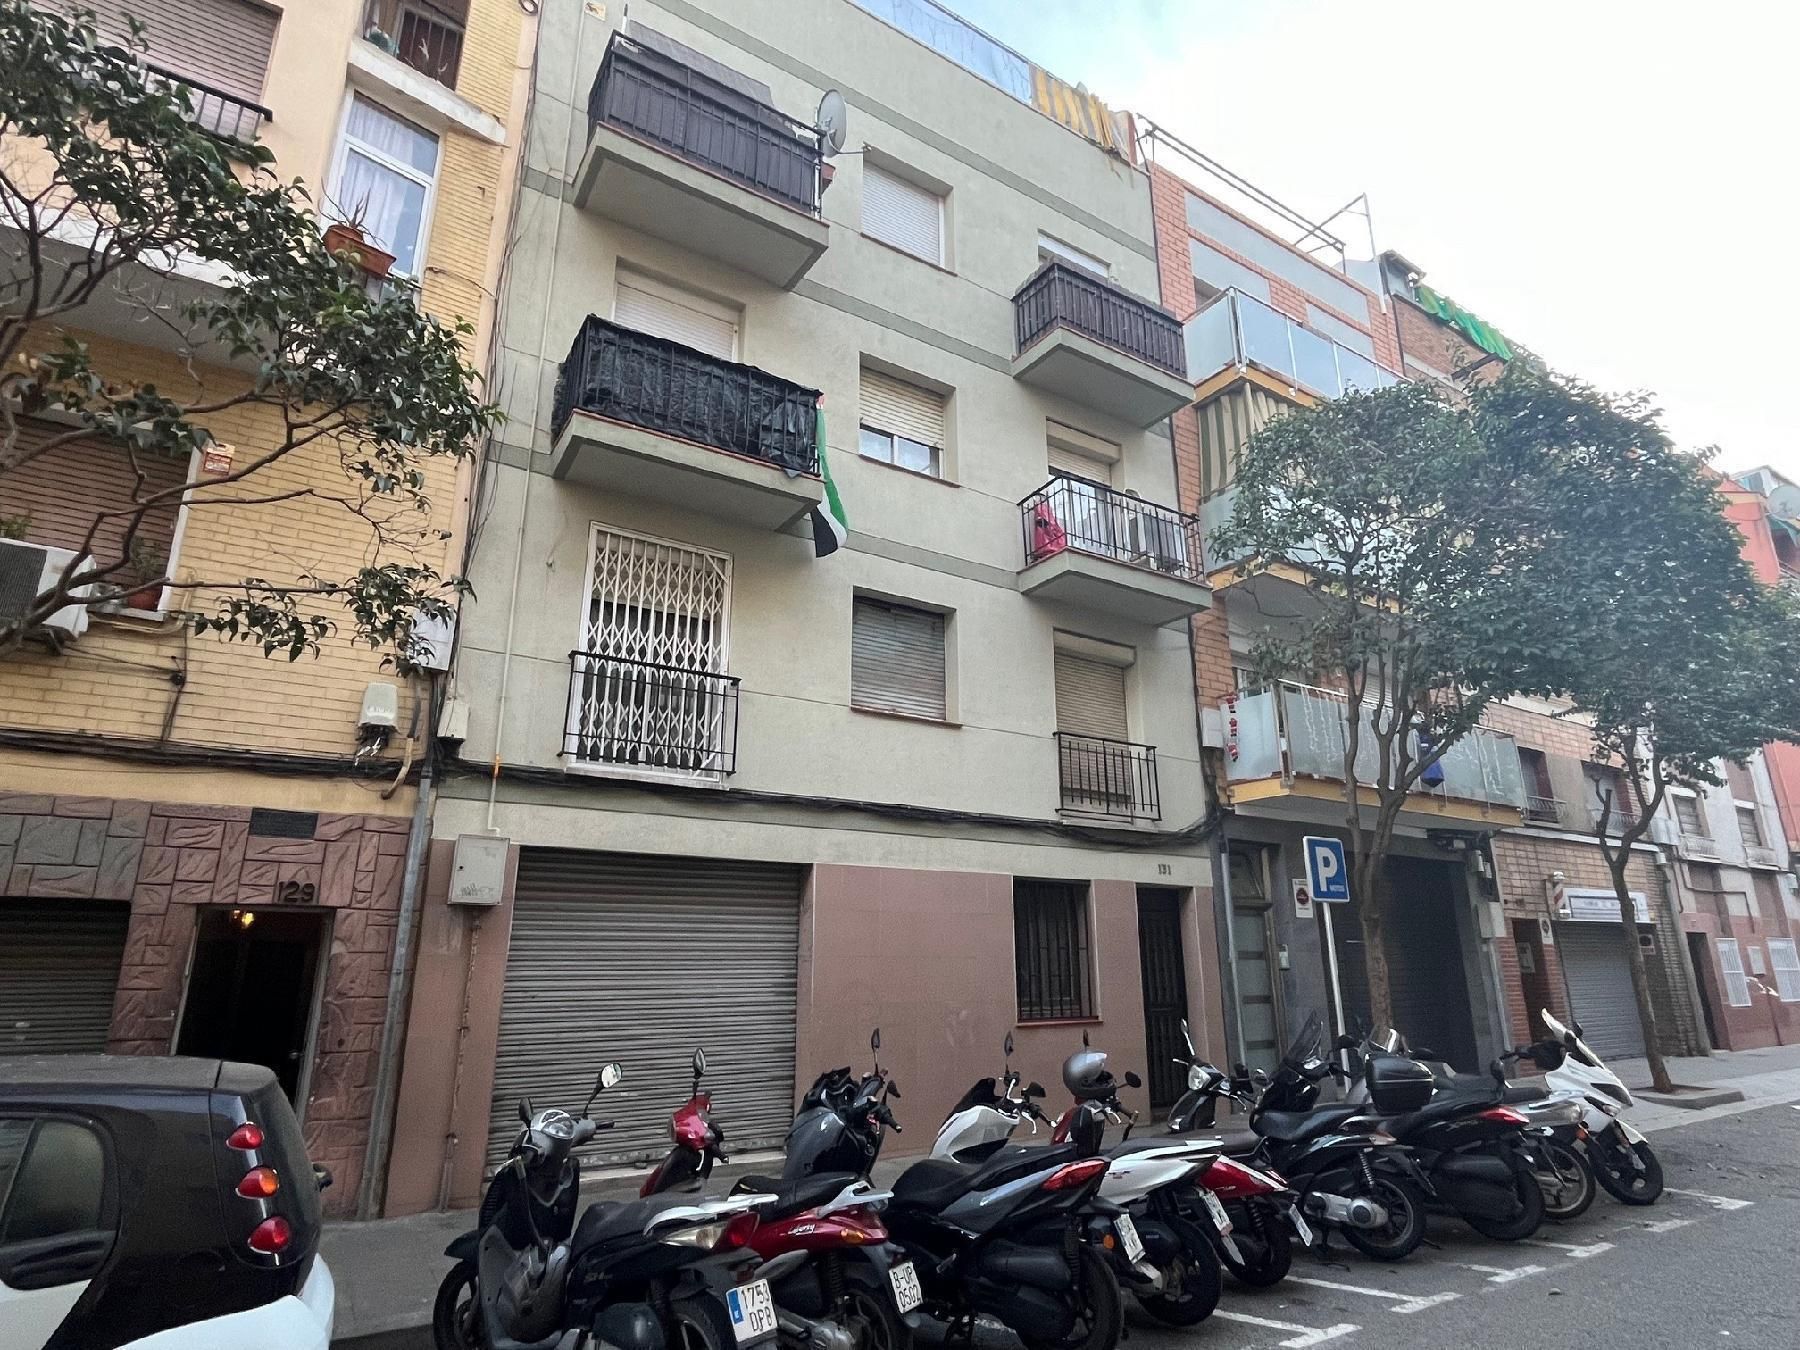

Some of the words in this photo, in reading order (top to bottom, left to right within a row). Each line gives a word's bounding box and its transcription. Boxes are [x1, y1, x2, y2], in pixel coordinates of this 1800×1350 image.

[1157, 863, 1171, 875] 131
[1315, 846, 1338, 892] P
[278, 880, 315, 902] 129
